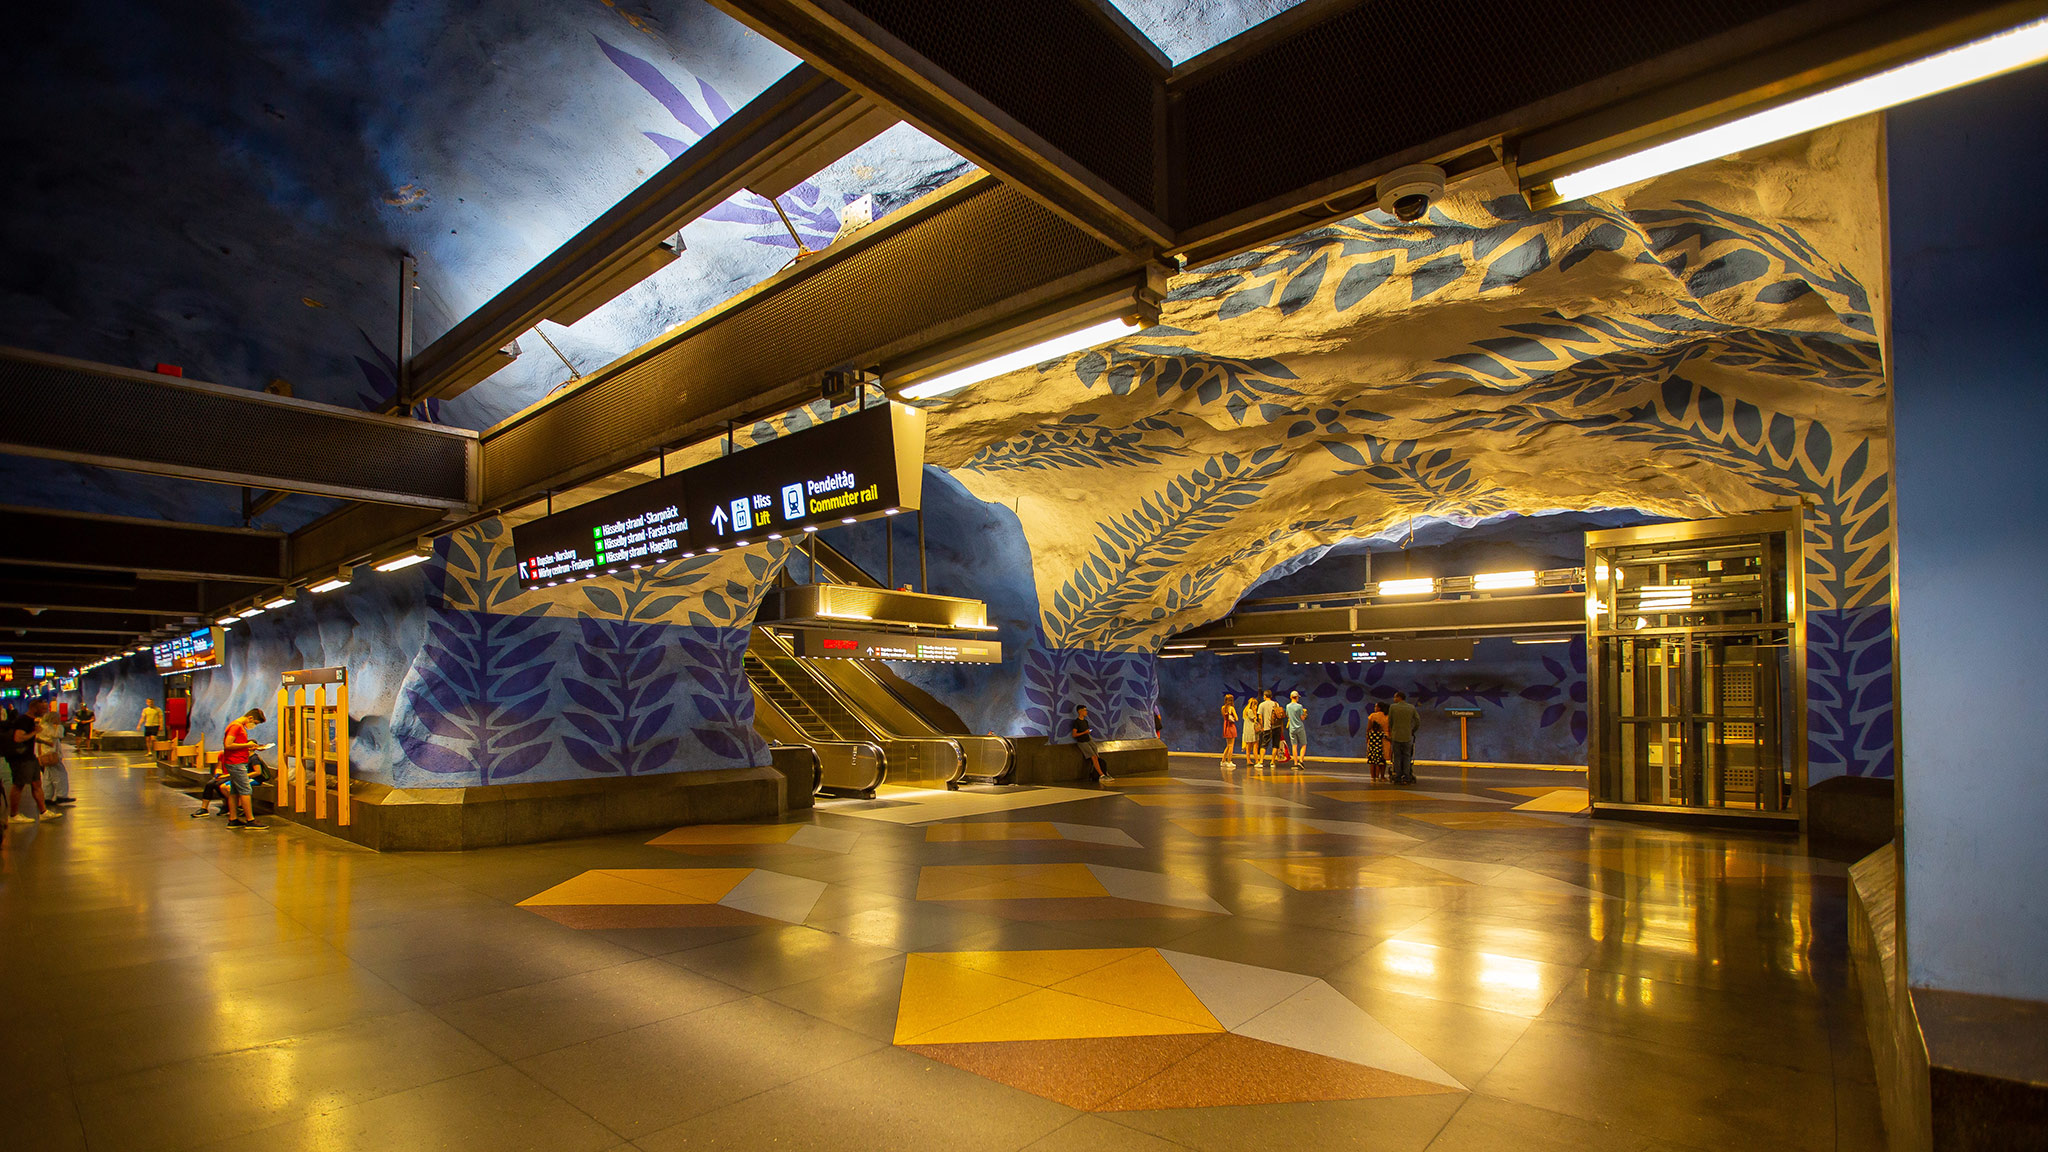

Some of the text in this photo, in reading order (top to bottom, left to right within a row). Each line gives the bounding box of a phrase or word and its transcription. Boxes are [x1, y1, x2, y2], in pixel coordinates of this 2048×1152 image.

[807, 470, 855, 496] Pendeltåg
[753, 494, 772, 510] Hiss
[809, 484, 878, 514] Commuter rail
[626, 514, 645, 530] strand
[646, 505, 679, 523] Skarpnäck
[755, 511, 771, 527] Lift
[628, 528, 647, 545] strand
[648, 525, 668, 540] Farsta
[667, 517, 689, 535] strand
[629, 543, 648, 558] strand
[649, 537, 678, 553] Hagsätra
